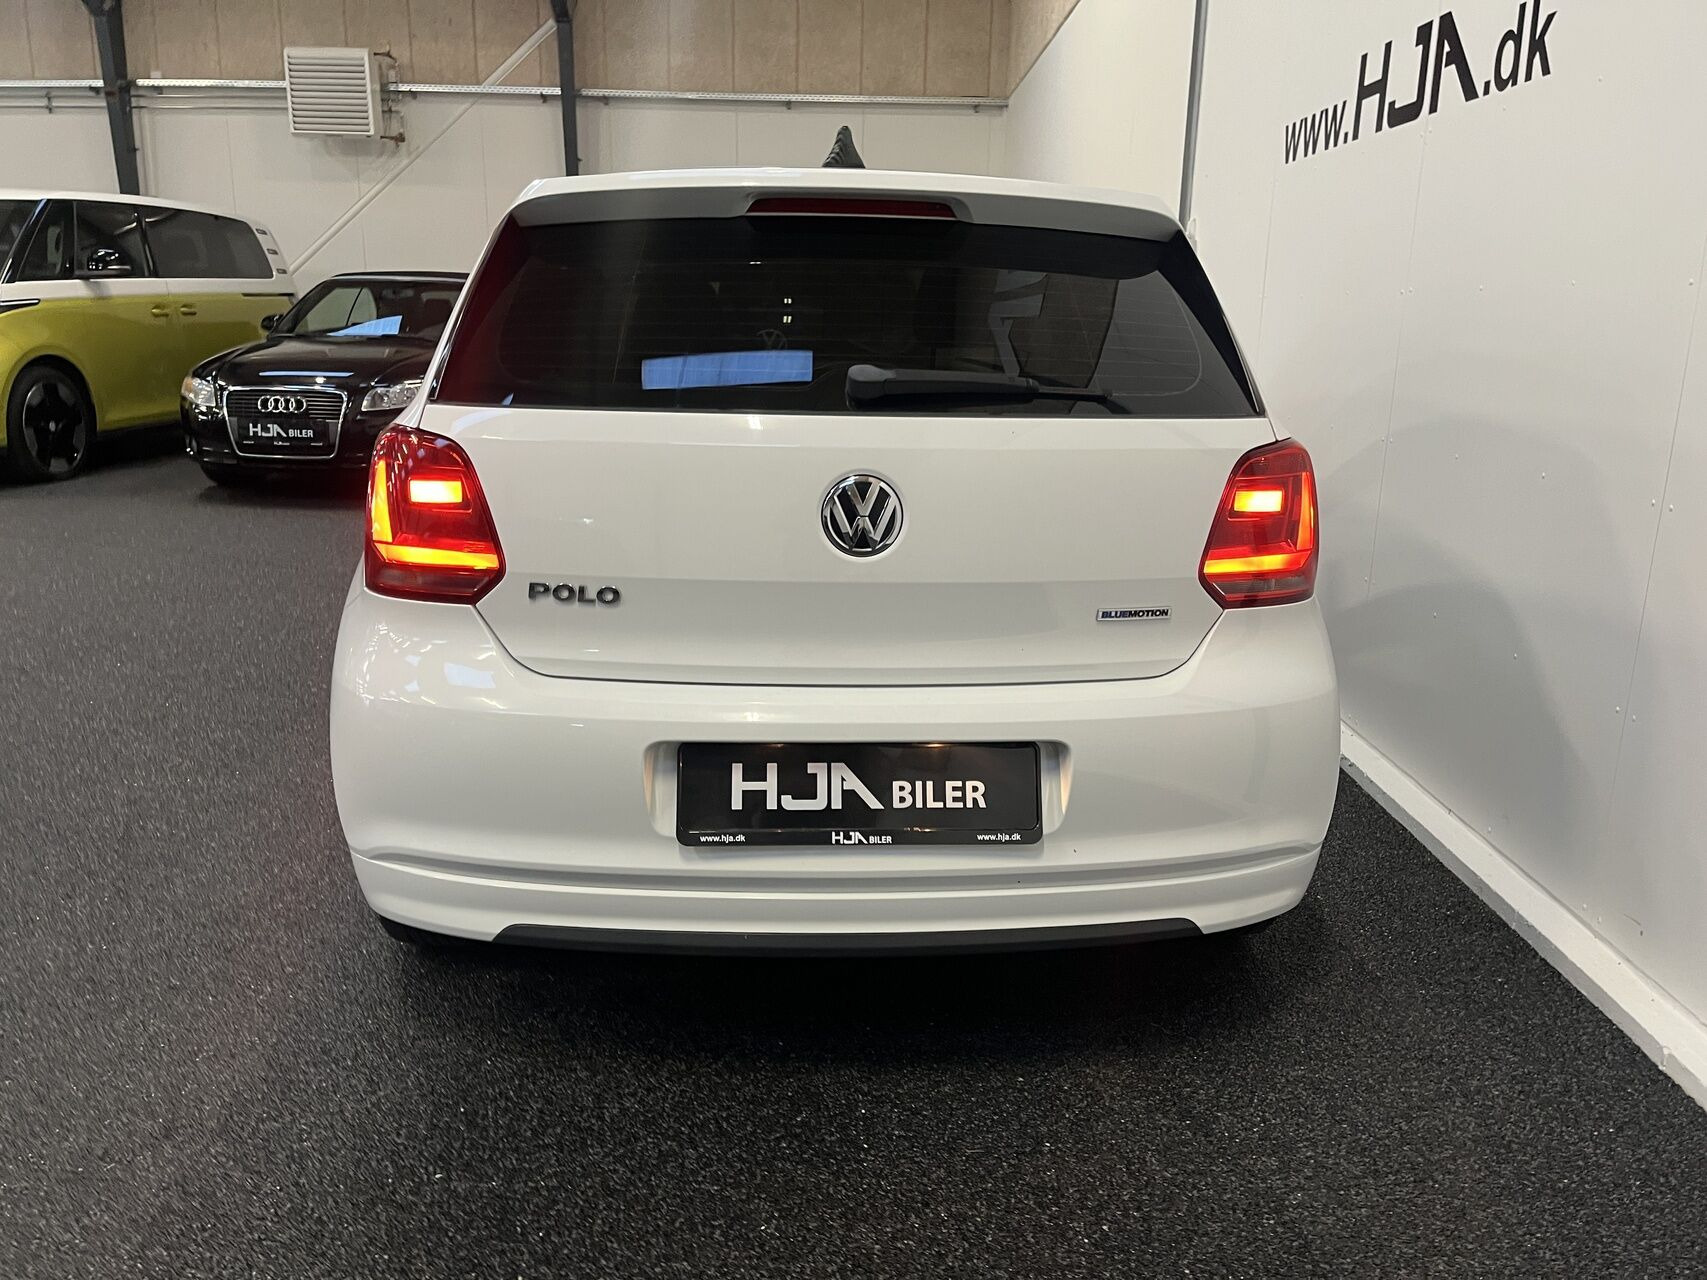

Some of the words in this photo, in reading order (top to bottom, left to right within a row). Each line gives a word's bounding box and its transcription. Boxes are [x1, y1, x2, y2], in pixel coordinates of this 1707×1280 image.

[1284, 0, 1558, 164] www.HJA.dk
[249, 423, 287, 437] HJA
[288, 429, 314, 438] BILER
[528, 582, 621, 605] POLO
[1101, 609, 1169, 618] BLUEMOTION
[731, 762, 885, 811] HJA
[892, 780, 987, 809] BILER
[699, 834, 746, 844] www.hja.dk
[831, 831, 868, 844] HJA
[869, 836, 893, 844] BILER
[976, 833, 1022, 842] www.hja.dk
